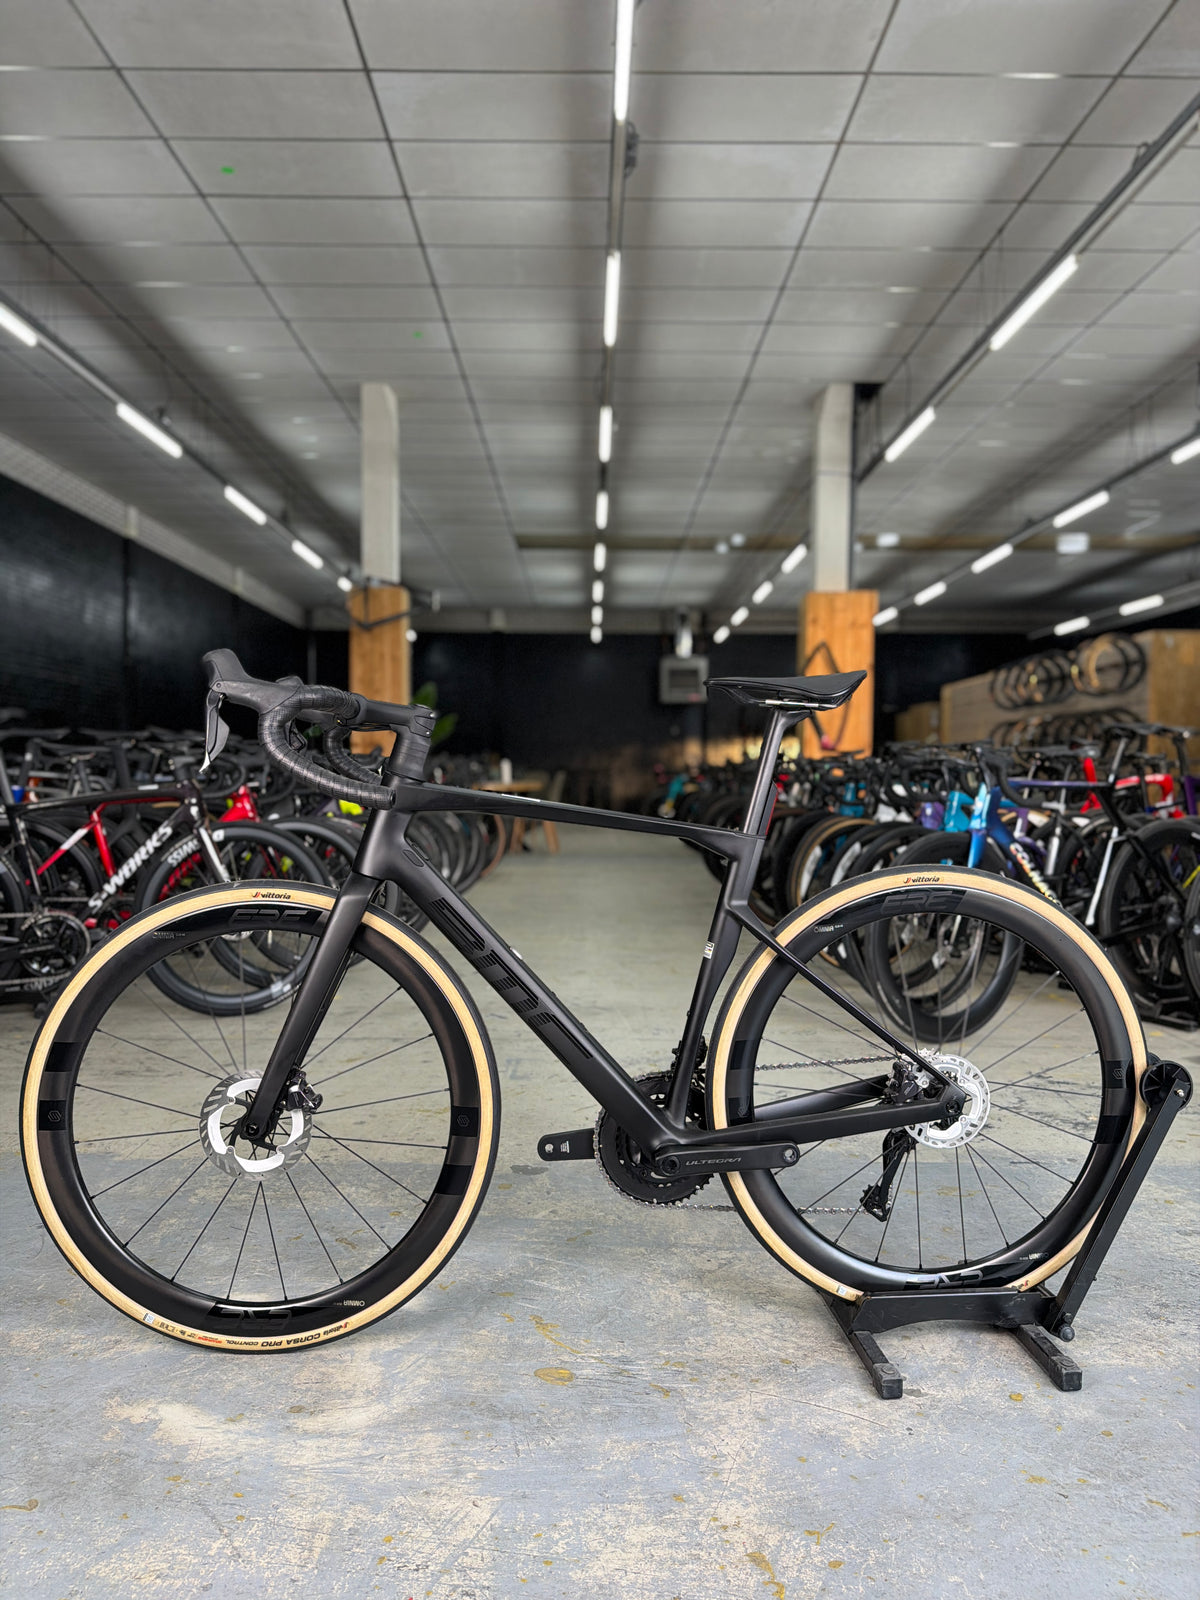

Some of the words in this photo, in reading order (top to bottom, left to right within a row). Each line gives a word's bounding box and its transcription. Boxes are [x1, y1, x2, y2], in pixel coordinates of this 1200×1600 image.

[910, 875, 940, 883] vittoria
[261, 892, 292, 900] vittoria
[685, 1157, 742, 1166] ULTEGRA
[343, 1299, 366, 1307] OMNIA
[322, 1323, 344, 1337] vittoria
[225, 1339, 259, 1347] CONTROL
[286, 1332, 321, 1346] CORSA
[260, 1339, 283, 1348] PRO
